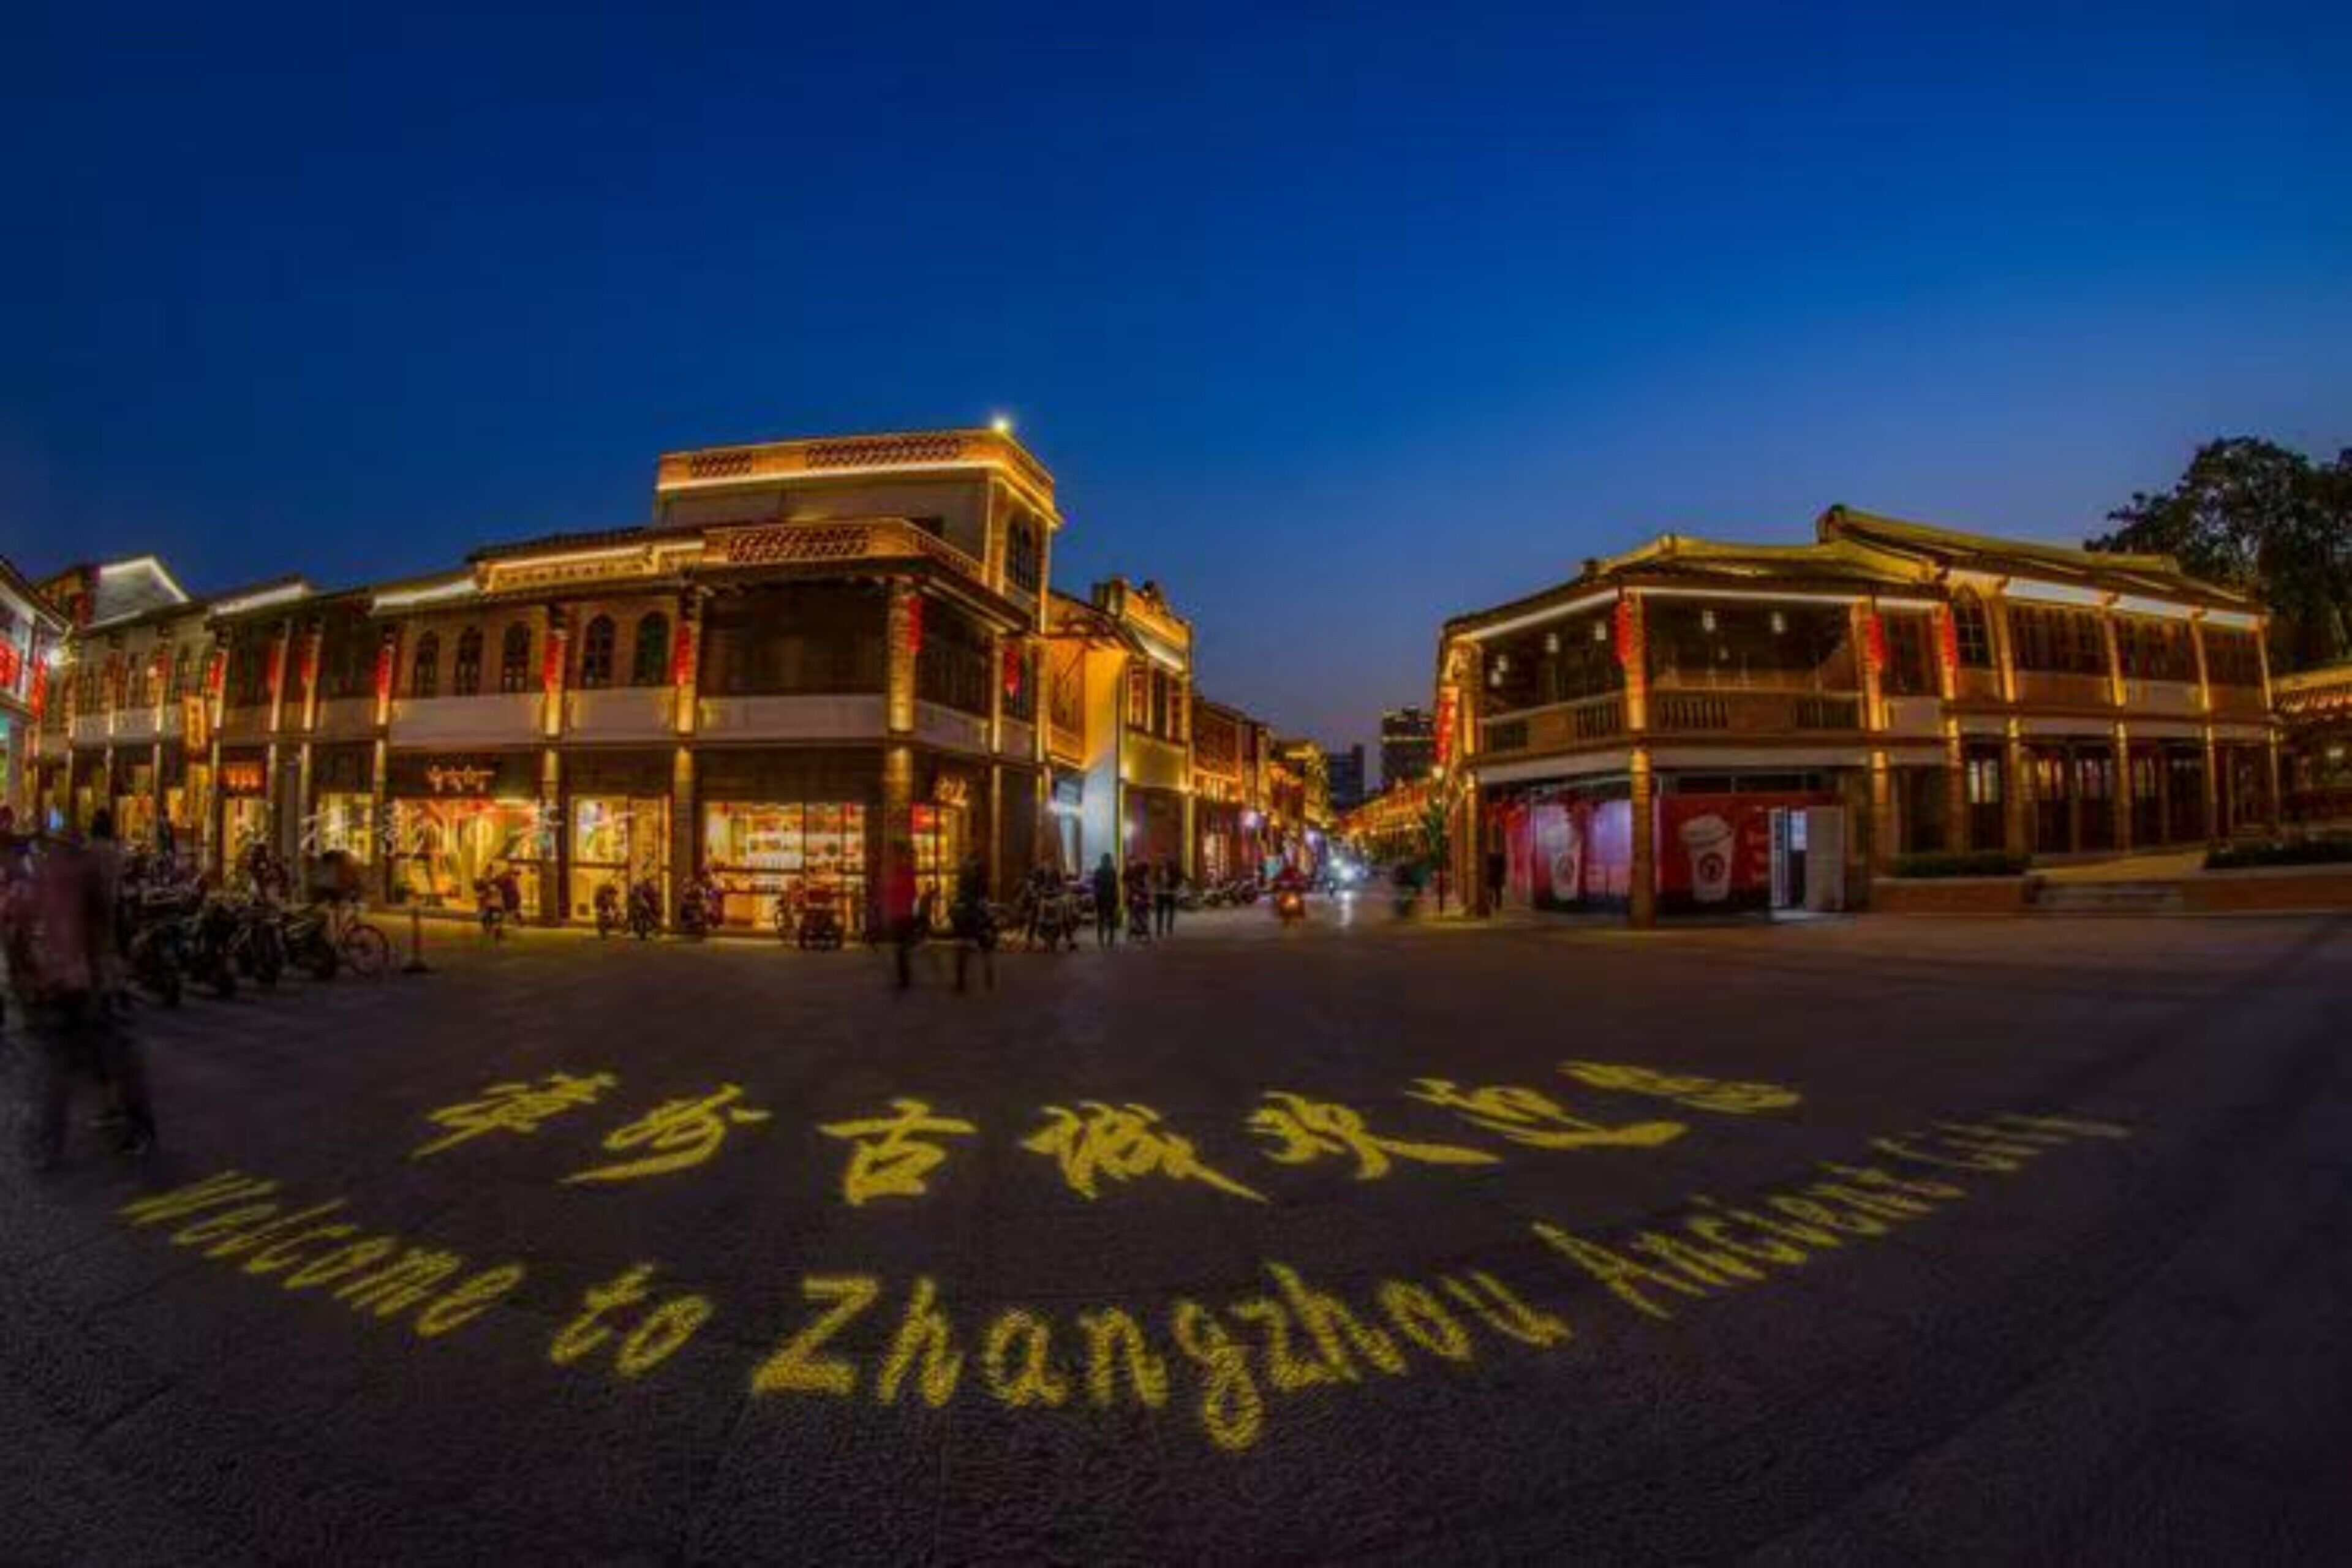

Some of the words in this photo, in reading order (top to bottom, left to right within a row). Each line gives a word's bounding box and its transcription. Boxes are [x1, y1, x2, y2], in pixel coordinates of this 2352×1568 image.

[120, 1169, 524, 1338] Welcome
[549, 1263, 713, 1379] to
[750, 1262, 1572, 1454] Zhangzhou
